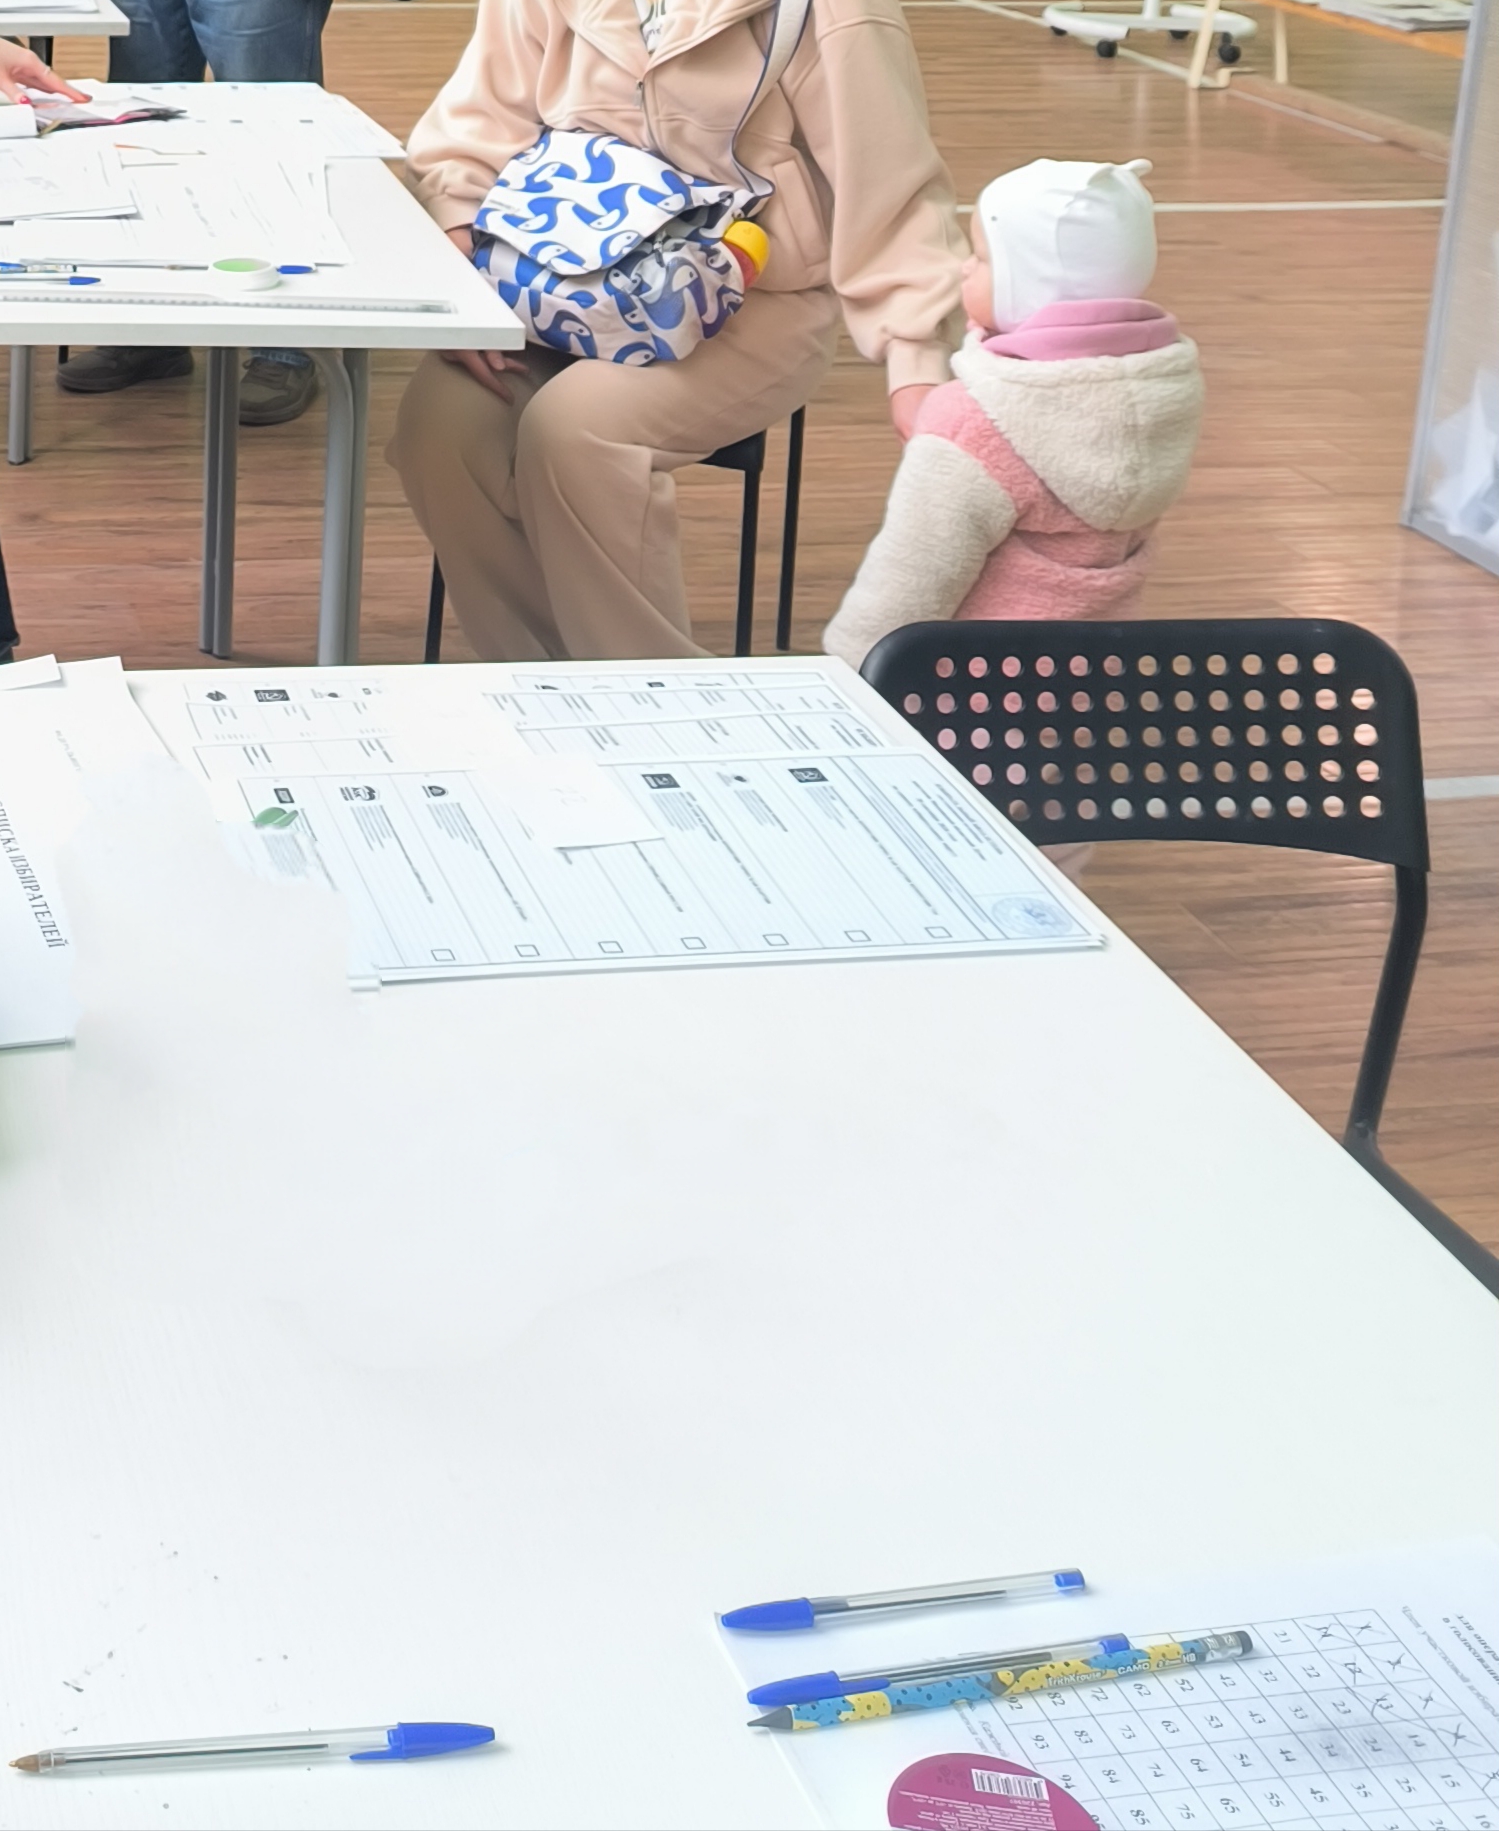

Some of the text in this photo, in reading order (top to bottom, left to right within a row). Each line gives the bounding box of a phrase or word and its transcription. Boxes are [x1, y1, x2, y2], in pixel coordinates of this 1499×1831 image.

[9, 854, 69, 948] ИЗБИРАТЕЛЕЙ
[1117, 1663, 1149, 1675] CAMO
[1182, 1653, 1196, 1663] HB
[1273, 1629, 1293, 1644] 21
[1301, 1664, 1321, 1679] 22
[1332, 1700, 1352, 1715] 23
[1395, 1776, 1417, 1794] 25
[1007, 1696, 1023, 1711] 92
[1030, 1734, 1050, 1750] 93
[1059, 1774, 1077, 1790] 94
[1047, 1692, 1150, 1826] 82 83 84 85
[1090, 1687, 1195, 1821] 72 73 74 75
[1133, 1682, 1241, 1814] 62 63 64 65
[1175, 1678, 1285, 1808] 52 53 54 55
[1219, 1674, 1329, 1803] 42 43 44 45
[1258, 1668, 1278, 1683] 32
[1288, 1705, 1309, 1720] 33
[1319, 1741, 1339, 1758] 34
[1351, 1781, 1373, 1798] 35
[1440, 1773, 1461, 1789] 15
[1474, 1814, 1492, 1829] 16
